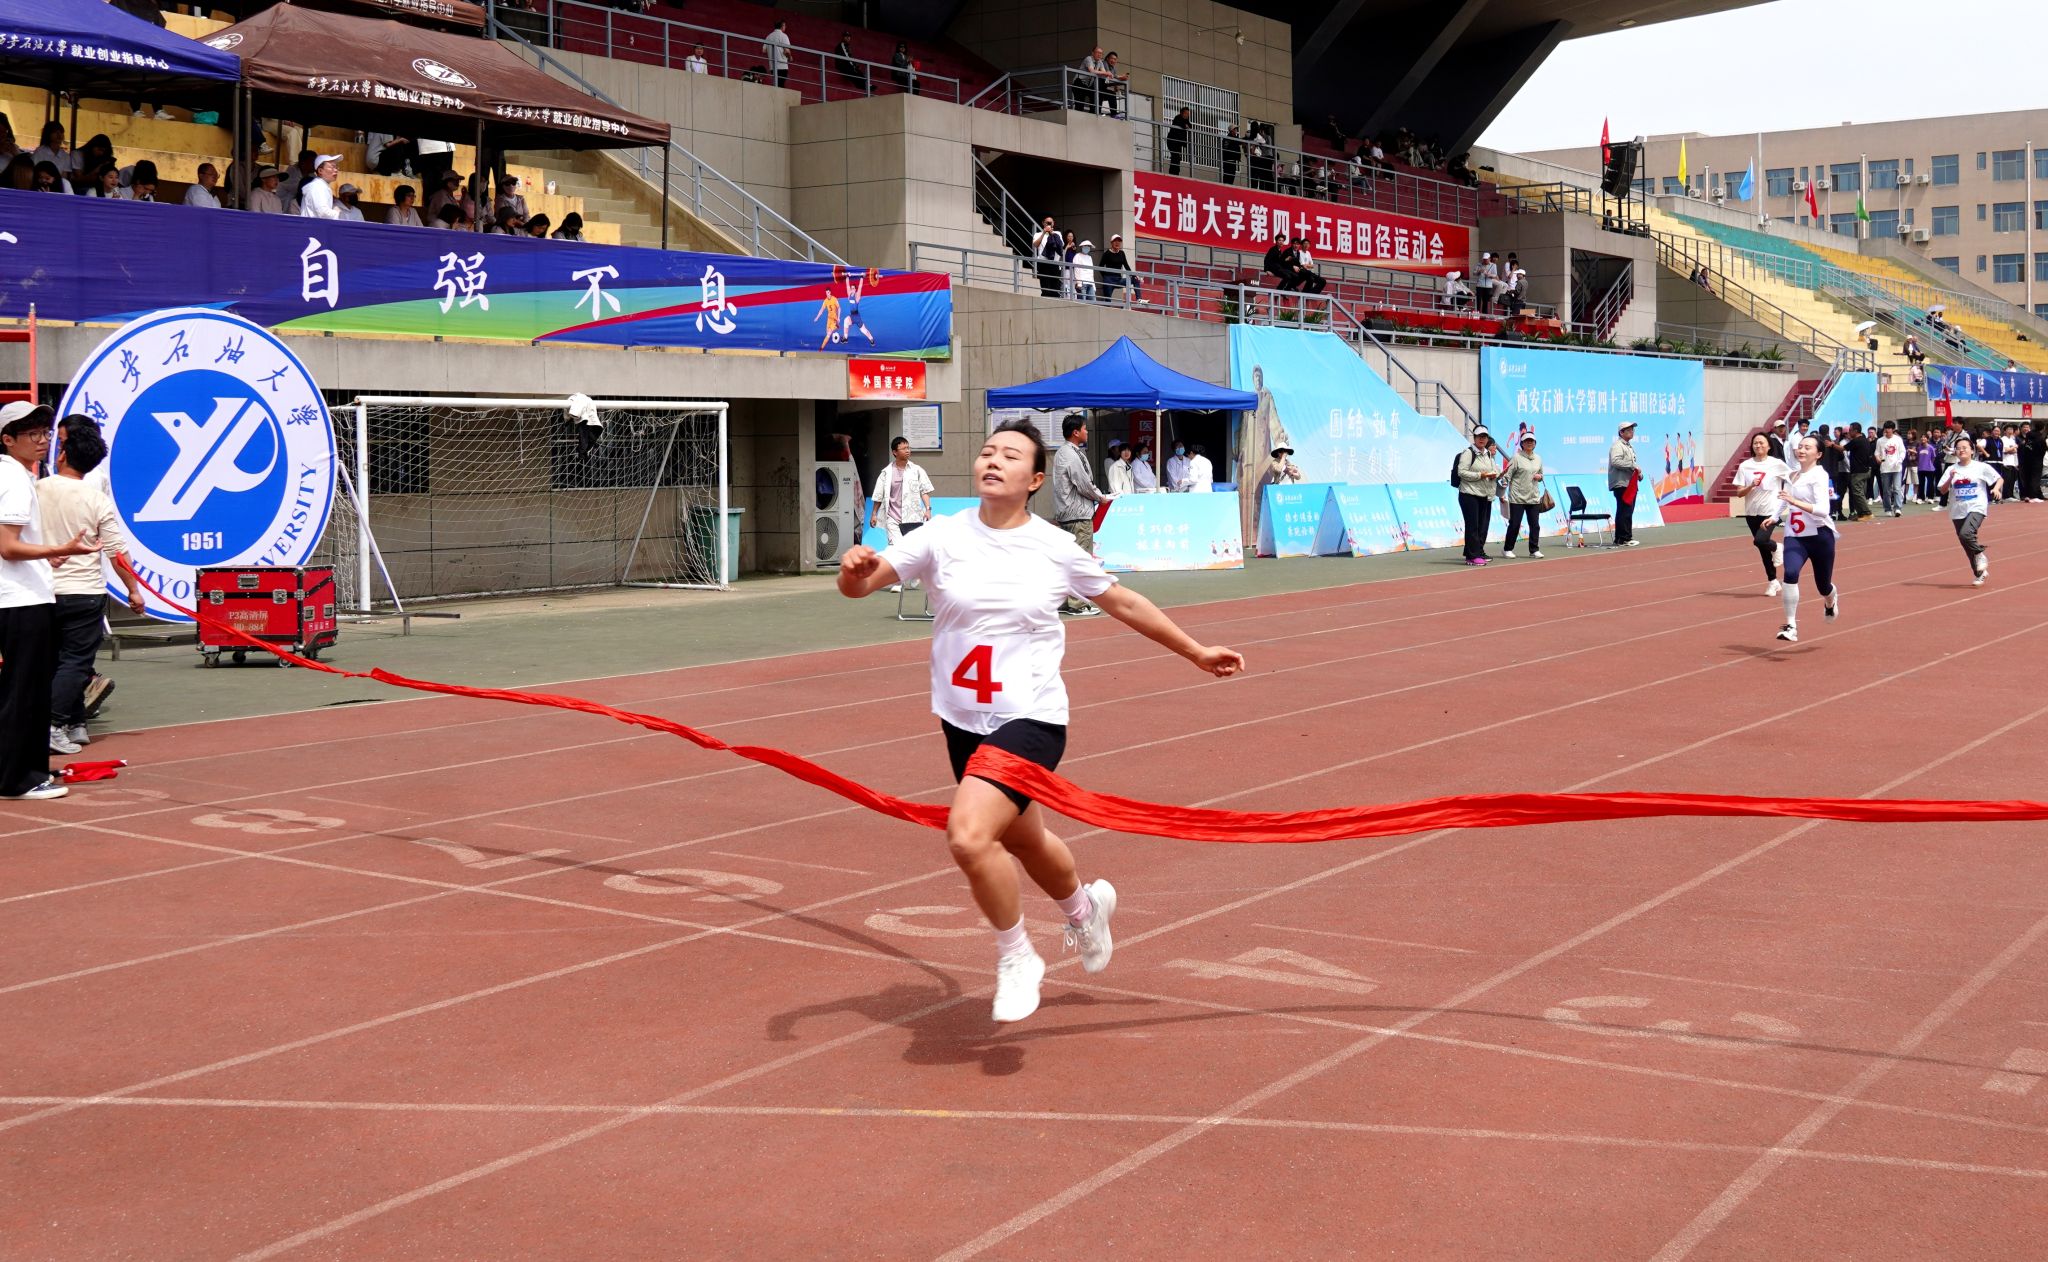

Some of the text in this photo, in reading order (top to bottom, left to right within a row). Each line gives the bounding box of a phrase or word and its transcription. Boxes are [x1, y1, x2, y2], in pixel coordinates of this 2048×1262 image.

[71, 43, 170, 71] 就业创业指导中心
[374, 83, 466, 110] 就业创业指导中心
[552, 110, 630, 136] 就业创业指导中心
[1134, 184, 1444, 267] 安石油大学第四十五届田径运动会
[300, 237, 738, 336] 自强不息
[863, 375, 914, 389] 外国语学院
[1516, 387, 1686, 416] 西安石油大学第四十五届田径运动会
[1753, 471, 1767, 487] 7
[1790, 511, 1806, 534] 5
[182, 531, 223, 551] 1951
[951, 644, 1003, 705] 4
